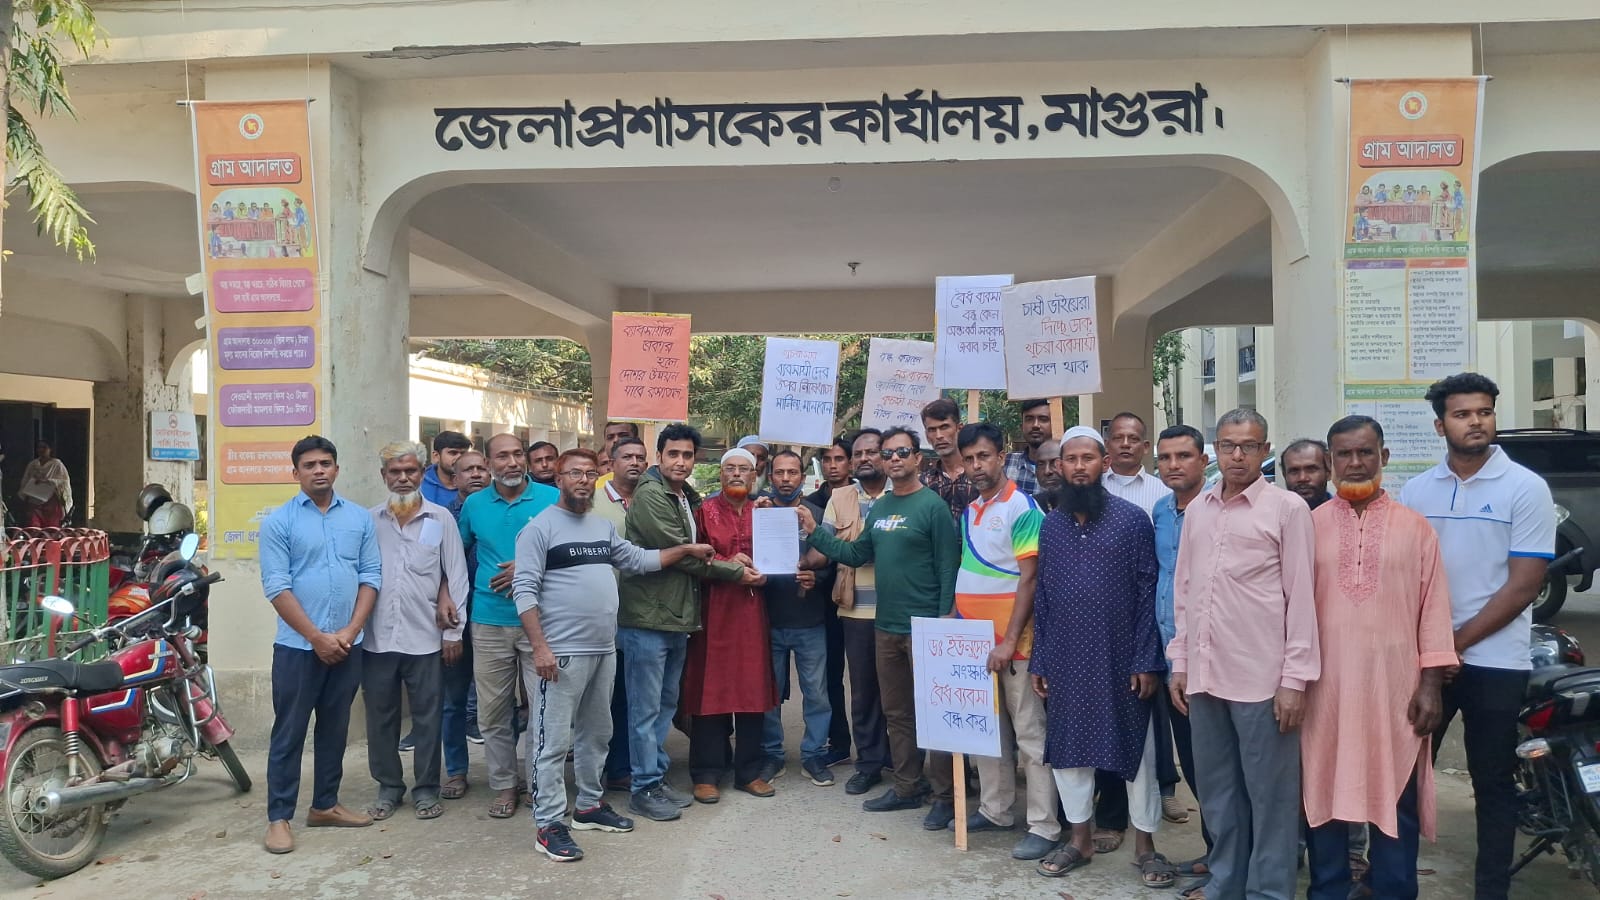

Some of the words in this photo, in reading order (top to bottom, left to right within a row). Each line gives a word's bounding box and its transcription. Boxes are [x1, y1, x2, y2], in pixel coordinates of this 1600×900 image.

[434, 99, 575, 151] জেলা
[576, 97, 824, 149] প্রশাসকের
[1041, 83, 1224, 138] মাগুরা।
[1362, 140, 1392, 160] গ্রাম
[1396, 140, 1456, 159] আদালত
[210, 159, 235, 178] গ্রাম
[238, 159, 294, 176] আদালত
[1022, 295, 1045, 316] চাষী
[1047, 293, 1089, 314] ভাইয়েরা
[1063, 360, 1088, 374] থাক
[954, 687, 988, 709] ব্যবসা
